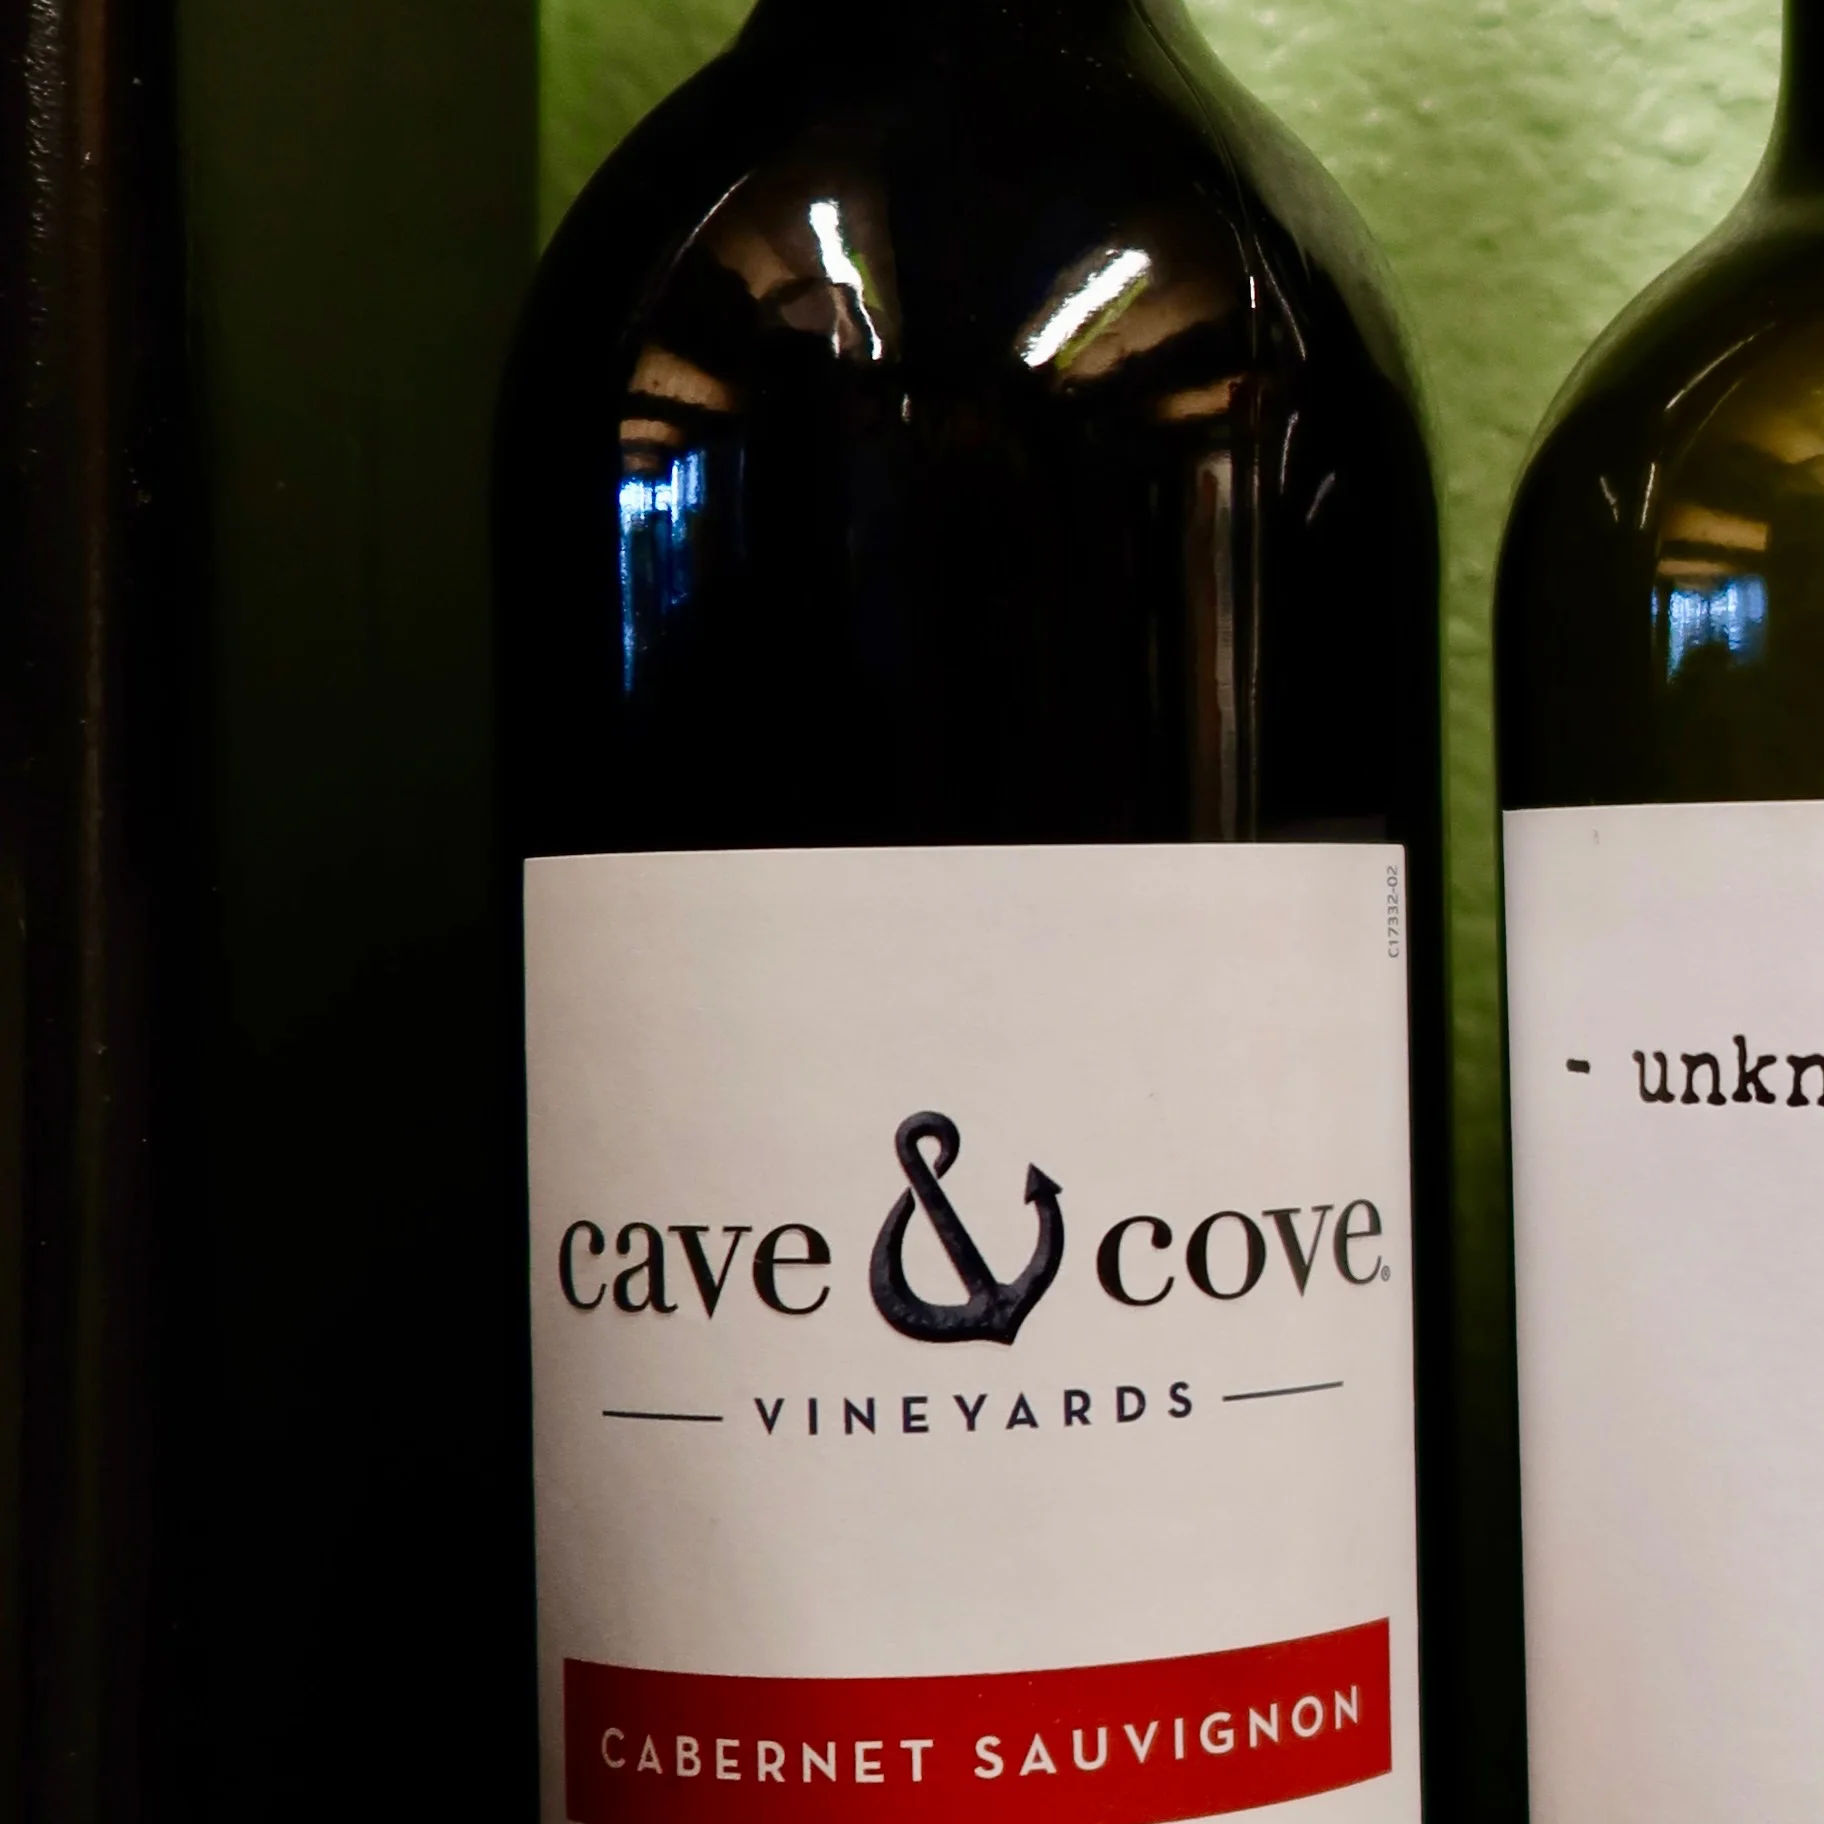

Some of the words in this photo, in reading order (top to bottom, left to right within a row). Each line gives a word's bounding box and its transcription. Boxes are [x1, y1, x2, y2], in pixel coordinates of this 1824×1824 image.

[556, 1218, 832, 1320] cave
[753, 1380, 1194, 1436] VINEYARDS
[601, 1726, 935, 1784] CABERNET
[973, 1683, 1362, 1781] SAUVIGNON
